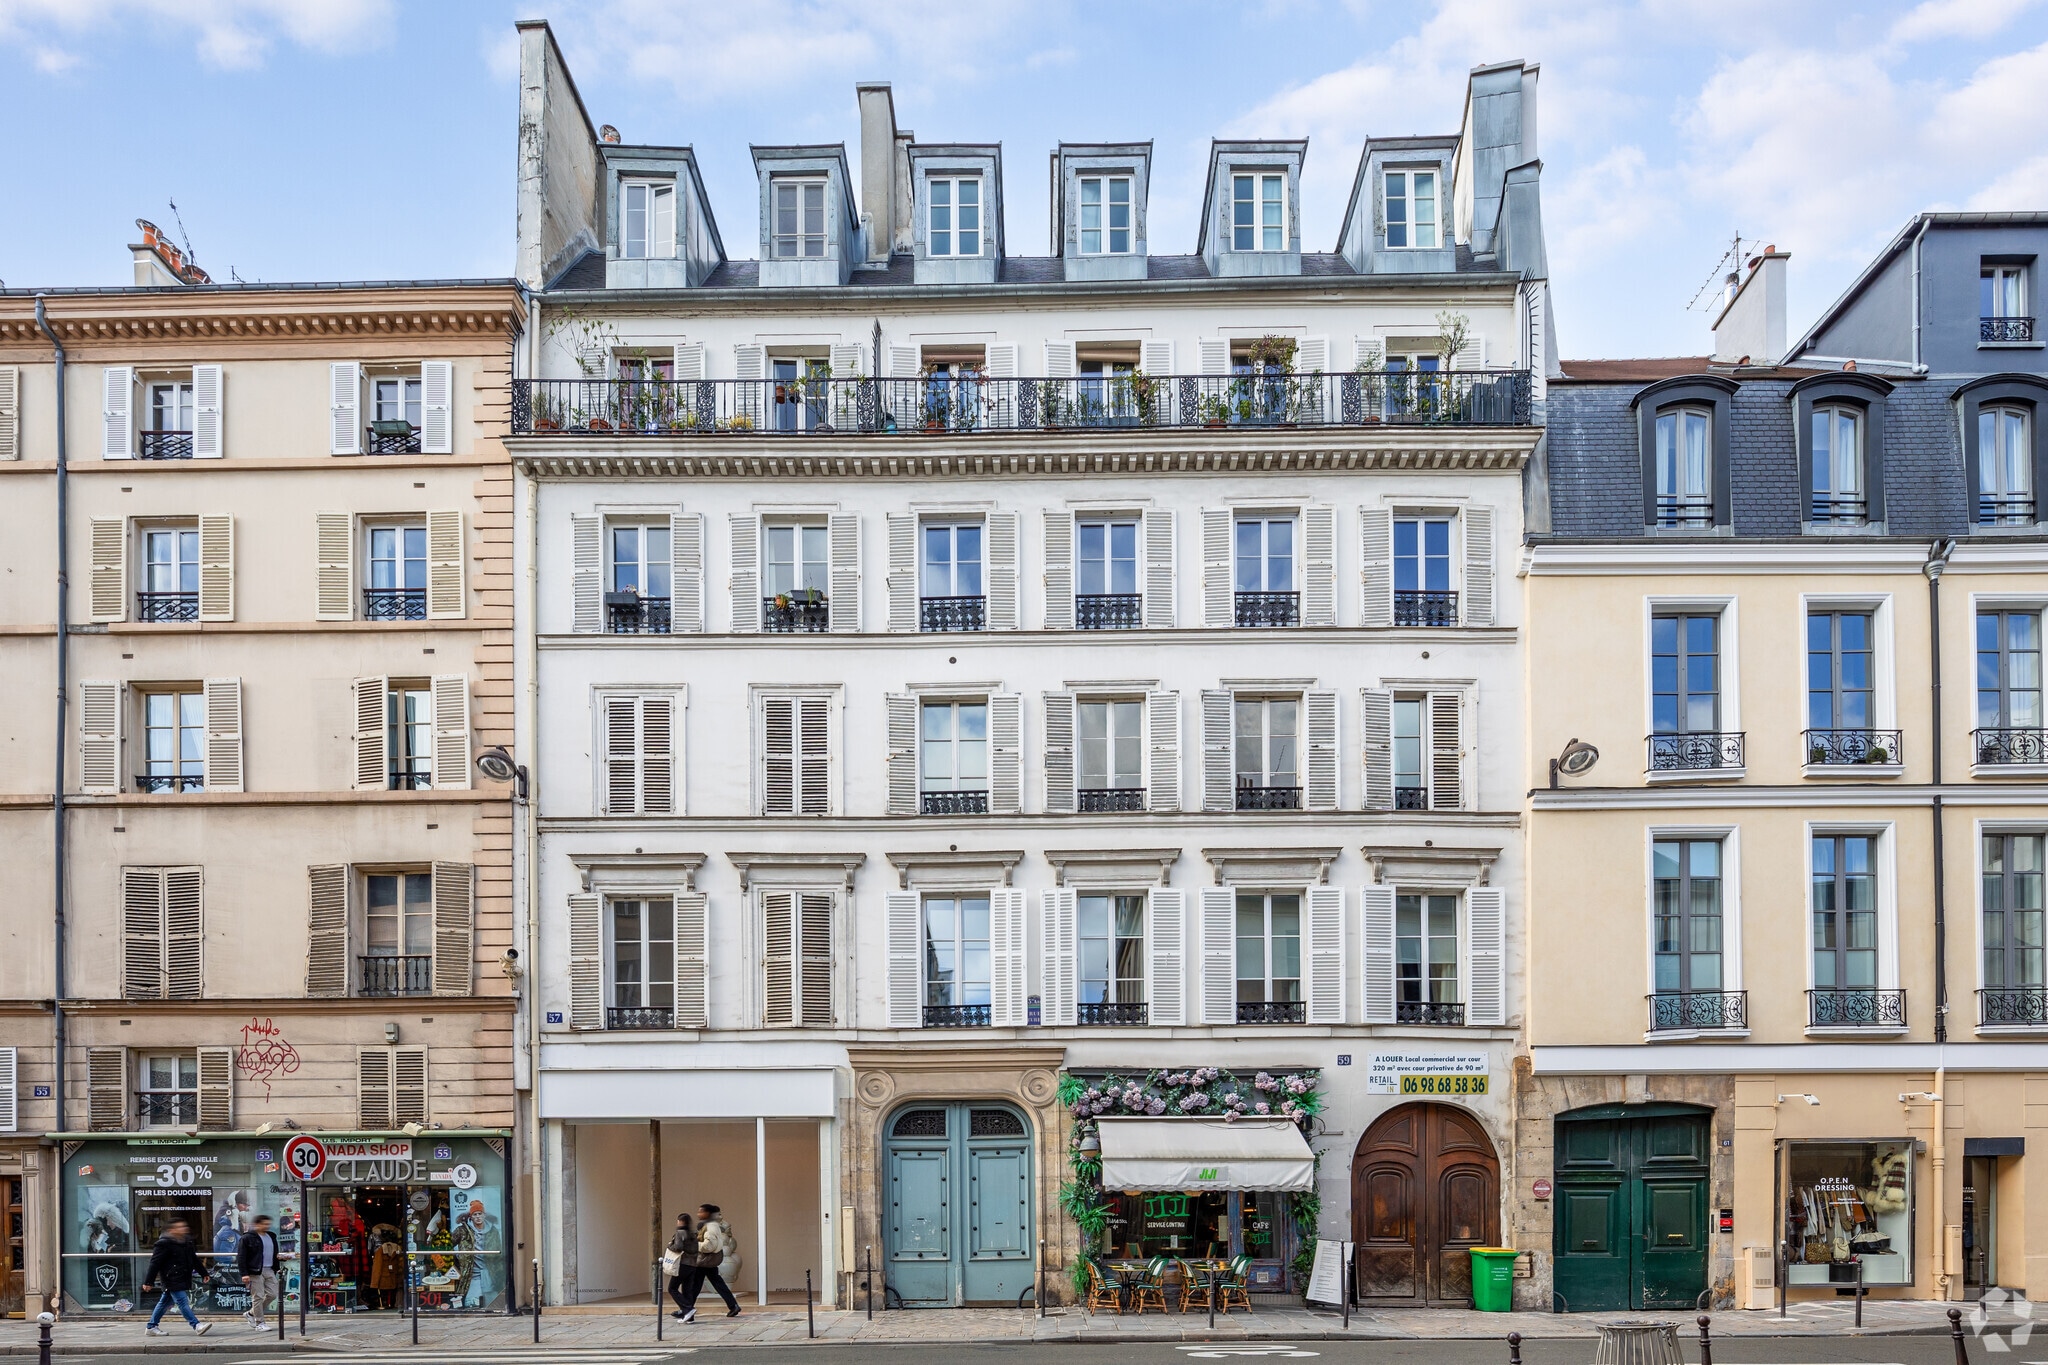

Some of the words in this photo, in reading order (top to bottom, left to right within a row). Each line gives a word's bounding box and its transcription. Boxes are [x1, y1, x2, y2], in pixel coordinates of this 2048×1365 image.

[549, 1013, 560, 1023] 57
[1338, 1055, 1350, 1065] 59
[36, 1086, 48, 1096] 55
[1404, 1077, 1418, 1093] 06
[1421, 1077, 1434, 1093] 98
[1438, 1077, 1451, 1093] 68
[1455, 1077, 1468, 1093] 58
[1471, 1077, 1485, 1093] 36
[259, 1151, 270, 1160] 55
[370, 1144, 409, 1155] SHOP
[437, 1149, 449, 1158] 55
[294, 1148, 319, 1168] 30
[334, 1160, 428, 1182] CLAUDE
[1199, 1168, 1217, 1180] JIJI
[1144, 1195, 1192, 1219] JIJI
[315, 1292, 337, 1307] 501
[420, 1291, 442, 1307] 501
